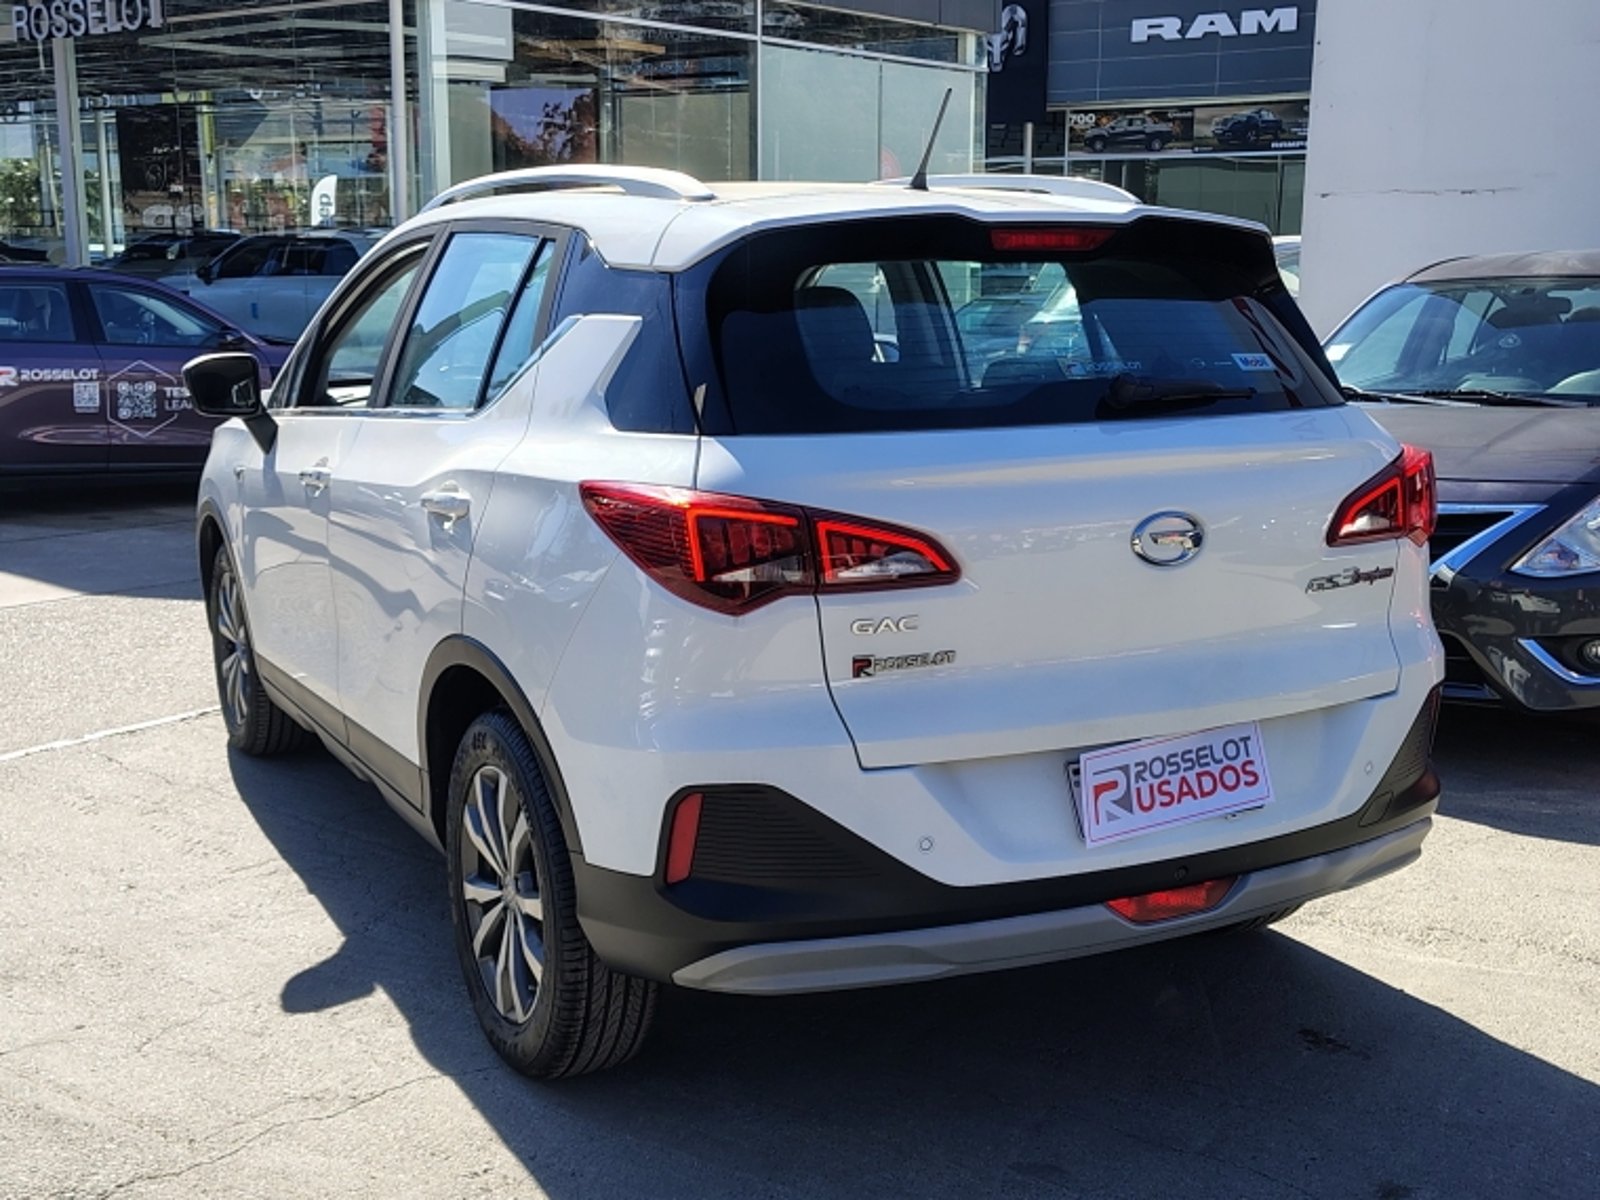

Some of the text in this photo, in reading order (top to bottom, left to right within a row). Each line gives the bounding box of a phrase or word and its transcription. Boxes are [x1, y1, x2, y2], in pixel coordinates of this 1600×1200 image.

[1131, 7, 1298, 42] RAM
[20, 368, 99, 381] ROSSELOT
[164, 386, 190, 398] TES
[850, 614, 919, 635] GAC
[1134, 735, 1251, 785] ROSSELOT
[1135, 759, 1260, 814] USADOS
